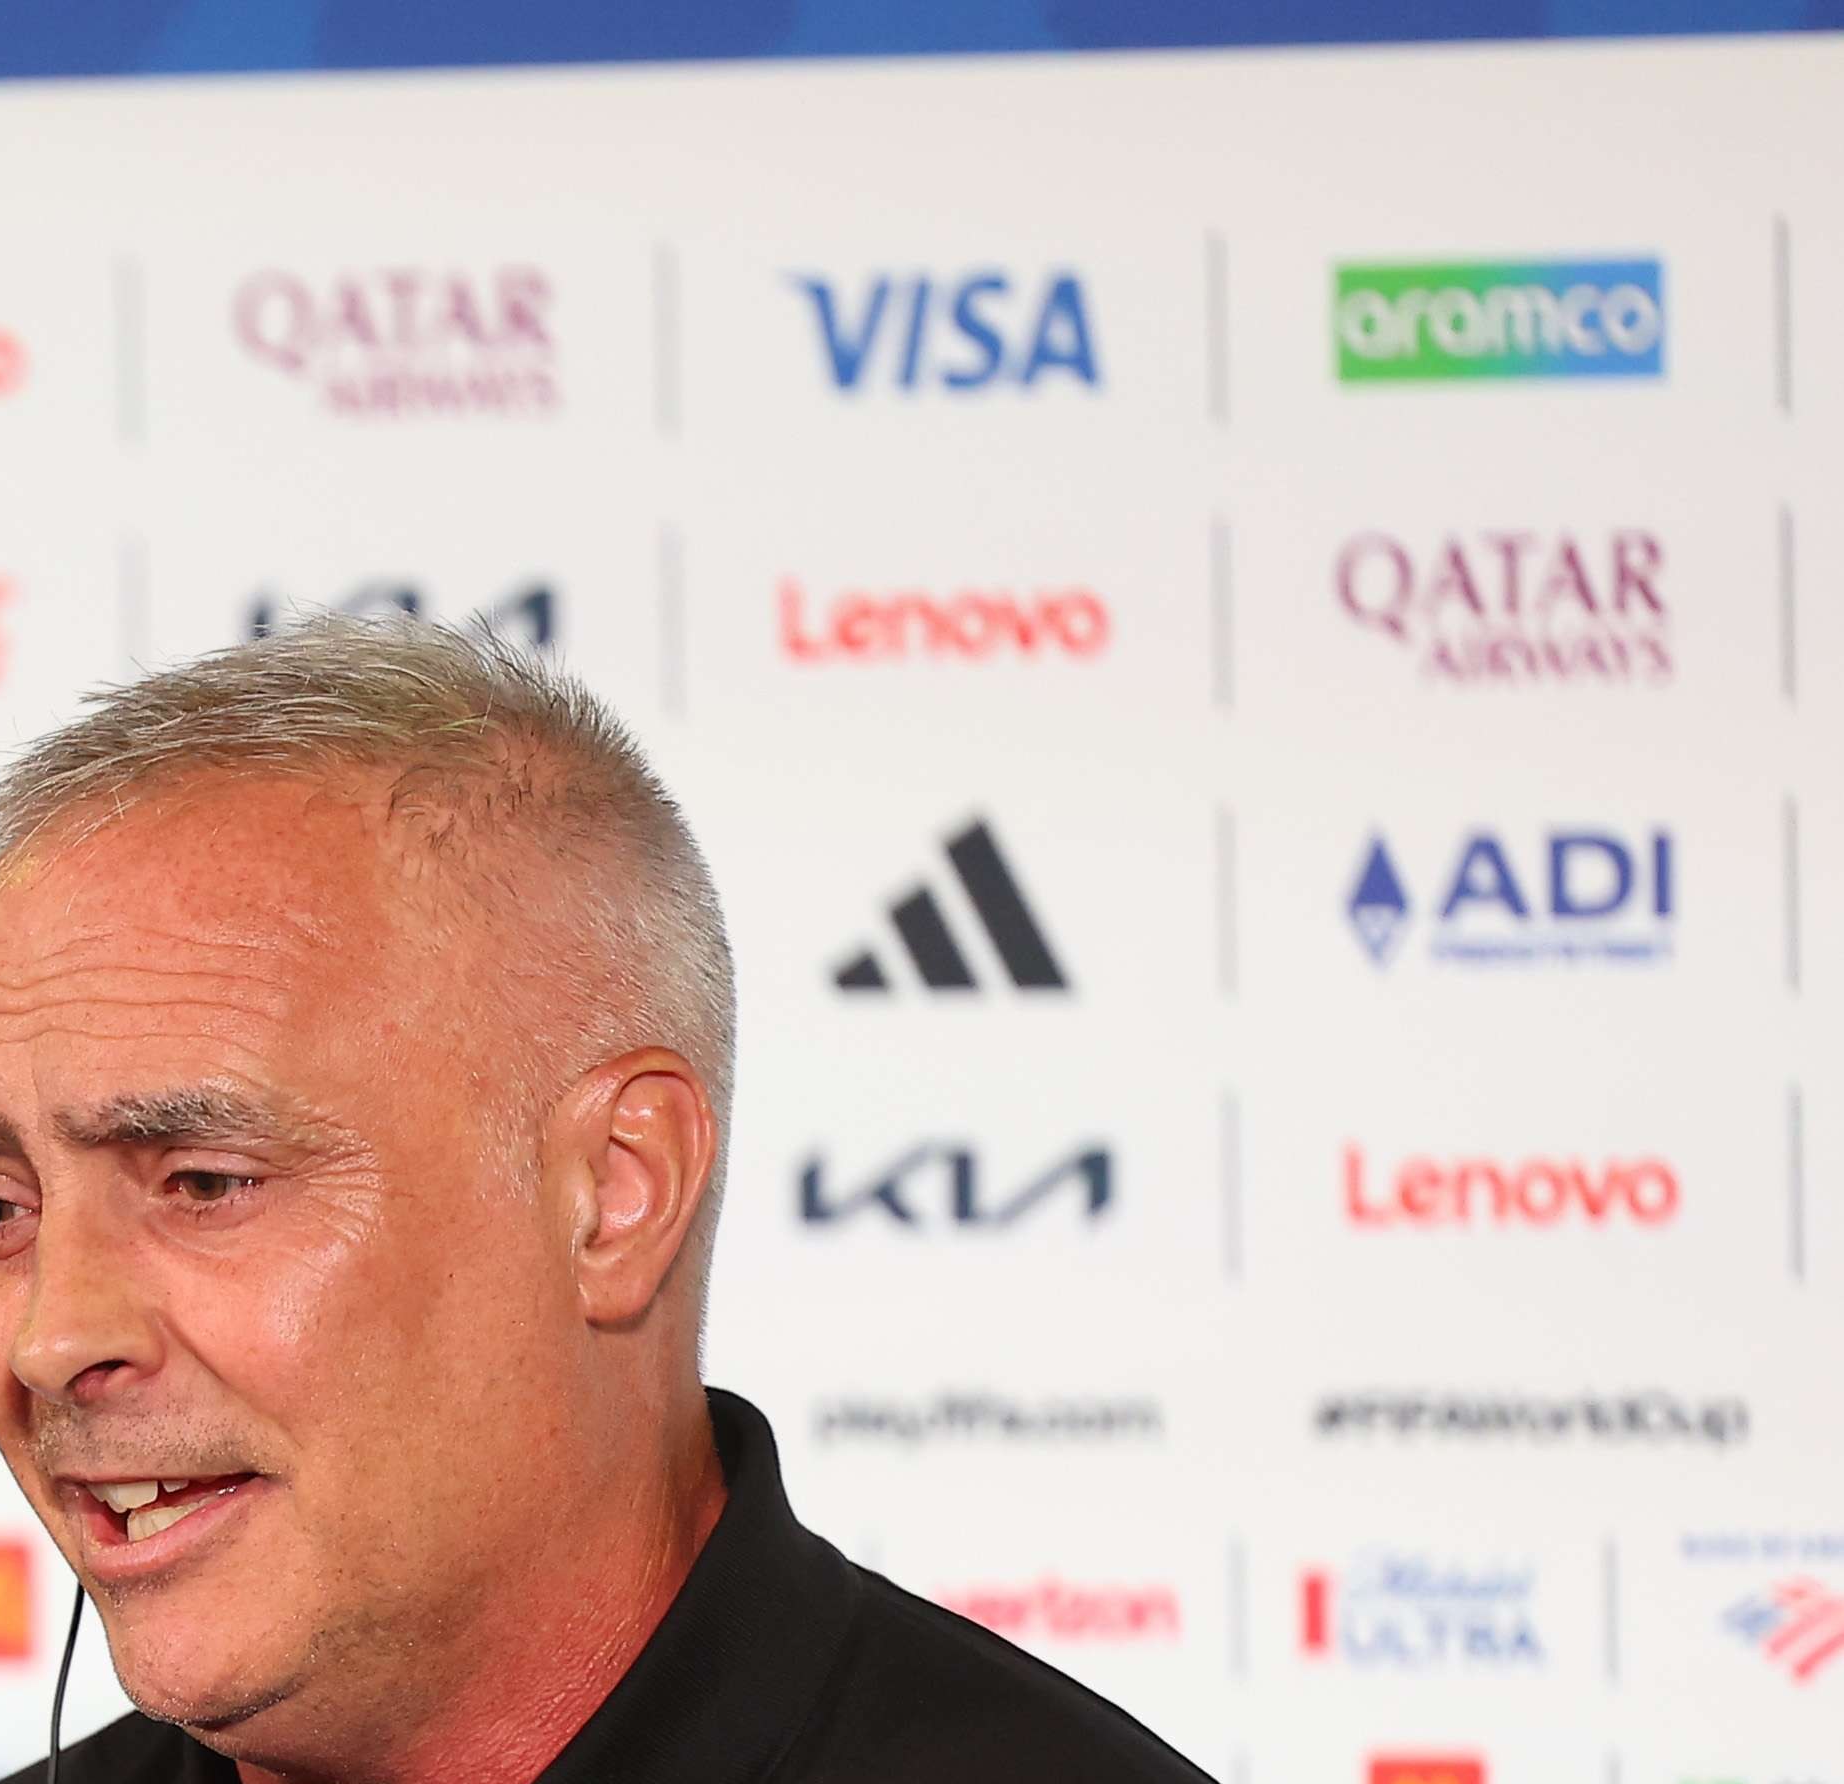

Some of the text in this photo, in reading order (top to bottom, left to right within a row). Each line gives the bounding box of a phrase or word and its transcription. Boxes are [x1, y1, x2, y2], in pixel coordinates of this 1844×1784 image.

[233, 266, 553, 374] QATAR
[791, 270, 1102, 394] VISA
[1341, 284, 1661, 360] aramco
[778, 580, 1111, 664] Lenovo
[1335, 530, 1665, 638] QATAR
[1425, 624, 1673, 682] AIRWAYS
[1439, 830, 1675, 920] ADI
[795, 1143, 1115, 1230] KIA
[1343, 1142, 1682, 1230] Lenovo
